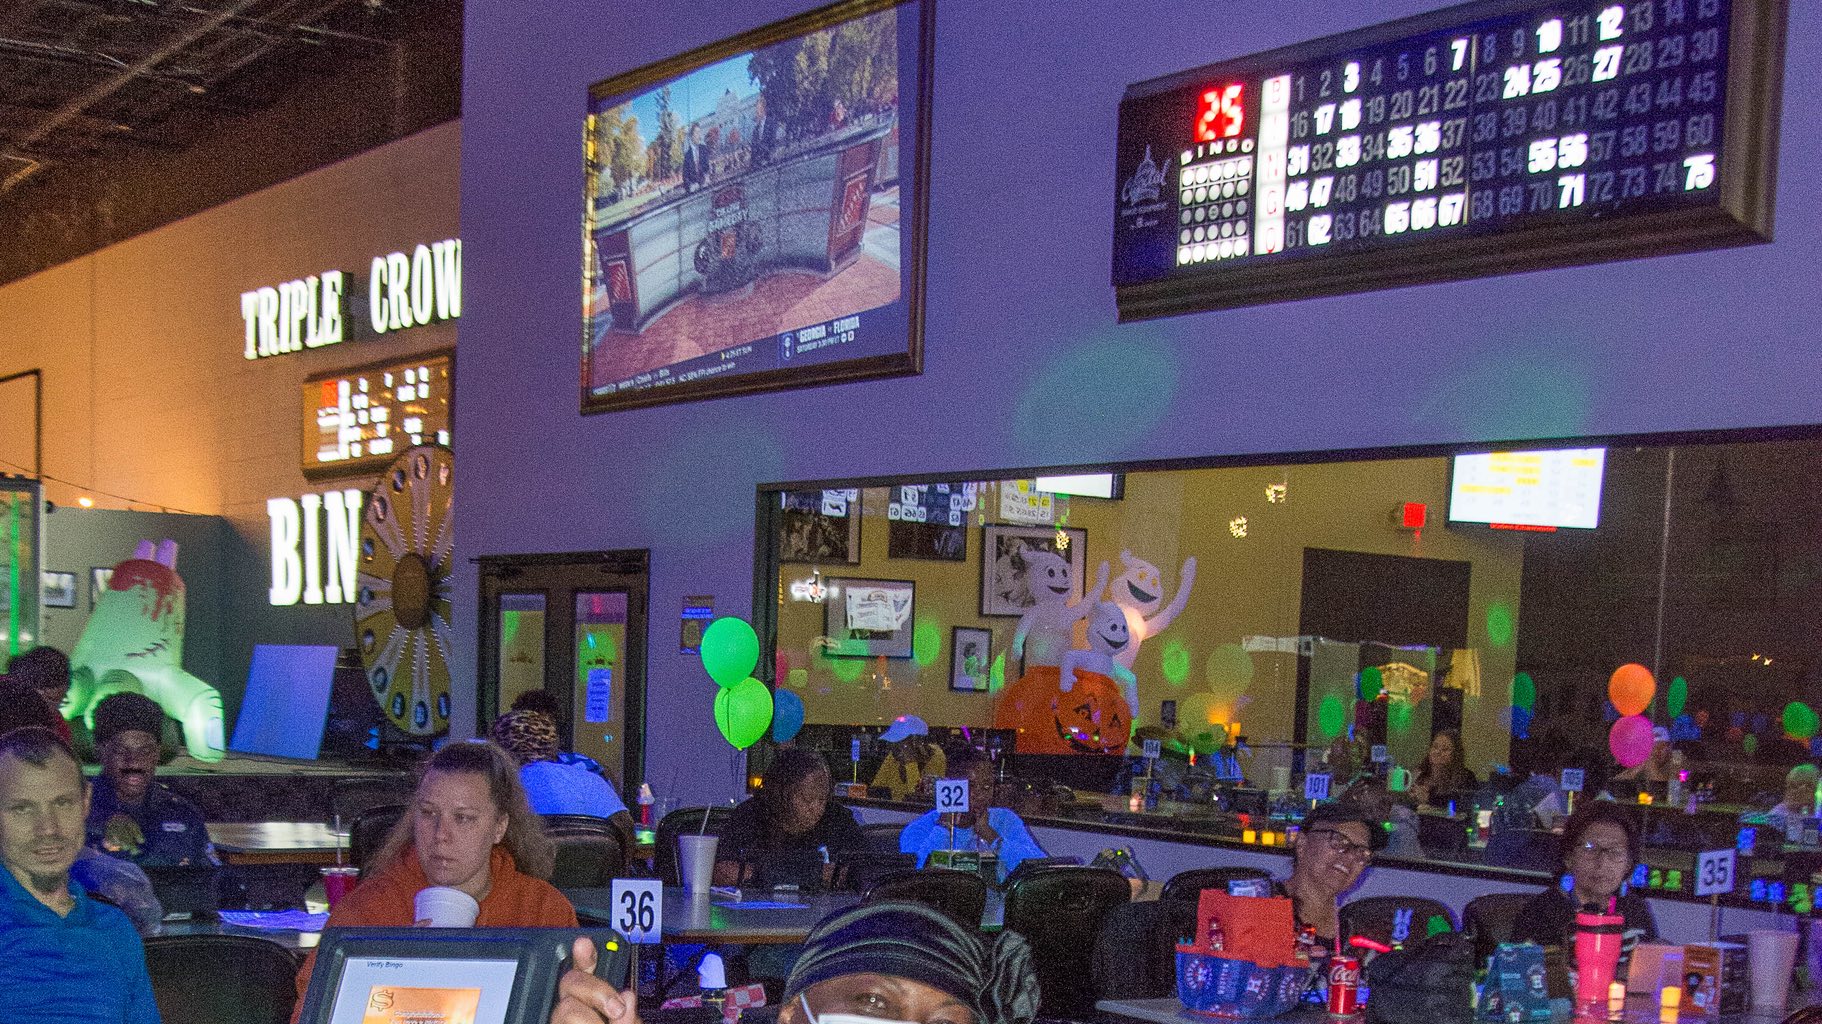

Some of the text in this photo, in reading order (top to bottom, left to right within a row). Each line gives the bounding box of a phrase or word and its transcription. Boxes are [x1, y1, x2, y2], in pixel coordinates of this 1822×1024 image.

[1291, 111, 1308, 138] 16
[1314, 104, 1336, 135] 17
[1366, 96, 1385, 124] 19
[1390, 90, 1412, 119] 20
[1418, 85, 1439, 115] 21
[1444, 79, 1468, 109] 22
[1476, 72, 1499, 102] 23
[1503, 65, 1531, 99] 24
[1532, 58, 1561, 93] 25
[1563, 55, 1588, 86] 26
[1592, 46, 1624, 82] 27
[1624, 42, 1652, 74] 28
[1658, 36, 1684, 68] 29
[1691, 28, 1719, 62] 30
[1298, 76, 1304, 101] 1
[1320, 71, 1331, 97] 2
[1344, 62, 1360, 92] 3
[1424, 47, 1436, 75] 6
[1451, 39, 1468, 71] 7
[1483, 34, 1497, 63] 8
[1512, 29, 1525, 57] 9
[1568, 16, 1588, 45] 11
[1597, 5, 1624, 41] 12
[1630, 3, 1652, 31] 13
[1198, 84, 1244, 142] 25
[1288, 144, 1310, 176] 31
[1312, 142, 1333, 172] 32
[1362, 132, 1384, 162] 34
[1387, 126, 1414, 159] 35
[1414, 121, 1441, 154] 36
[1442, 118, 1467, 150] 37
[1473, 112, 1497, 143] 38
[1501, 107, 1526, 138] 39
[1531, 101, 1556, 131] 40
[1562, 95, 1587, 126] 41
[1591, 88, 1618, 120] 42
[1623, 83, 1650, 115] 43
[1655, 77, 1681, 109] 44
[1687, 70, 1716, 101] 45
[1286, 220, 1304, 248] 61
[1308, 214, 1332, 245] 62
[1334, 212, 1355, 241] 63
[1359, 209, 1381, 237] 64
[1384, 202, 1410, 234] 65
[1411, 197, 1438, 230] 66
[1438, 193, 1465, 226] 67
[1471, 189, 1493, 220] 68
[1499, 184, 1524, 215] 69
[1558, 174, 1585, 208] 71
[1620, 167, 1646, 197] 73
[1683, 154, 1714, 191] 75
[1310, 176, 1334, 208] 47
[1335, 174, 1357, 203] 48
[1361, 169, 1383, 198] 49
[1387, 165, 1410, 195] 50
[1414, 158, 1439, 191] 51
[1441, 156, 1464, 187] 52
[1528, 138, 1557, 173] 55
[1558, 133, 1588, 169] 56
[1653, 119, 1680, 151] 59
[1685, 114, 1714, 147] 60
[241, 270, 343, 360] TRIPLE
[267, 489, 363, 606] BIN
[941, 785, 964, 808] 32
[620, 890, 655, 933] 36
[1703, 857, 1729, 886] 35
[367, 961, 404, 969] Verify Bingo
